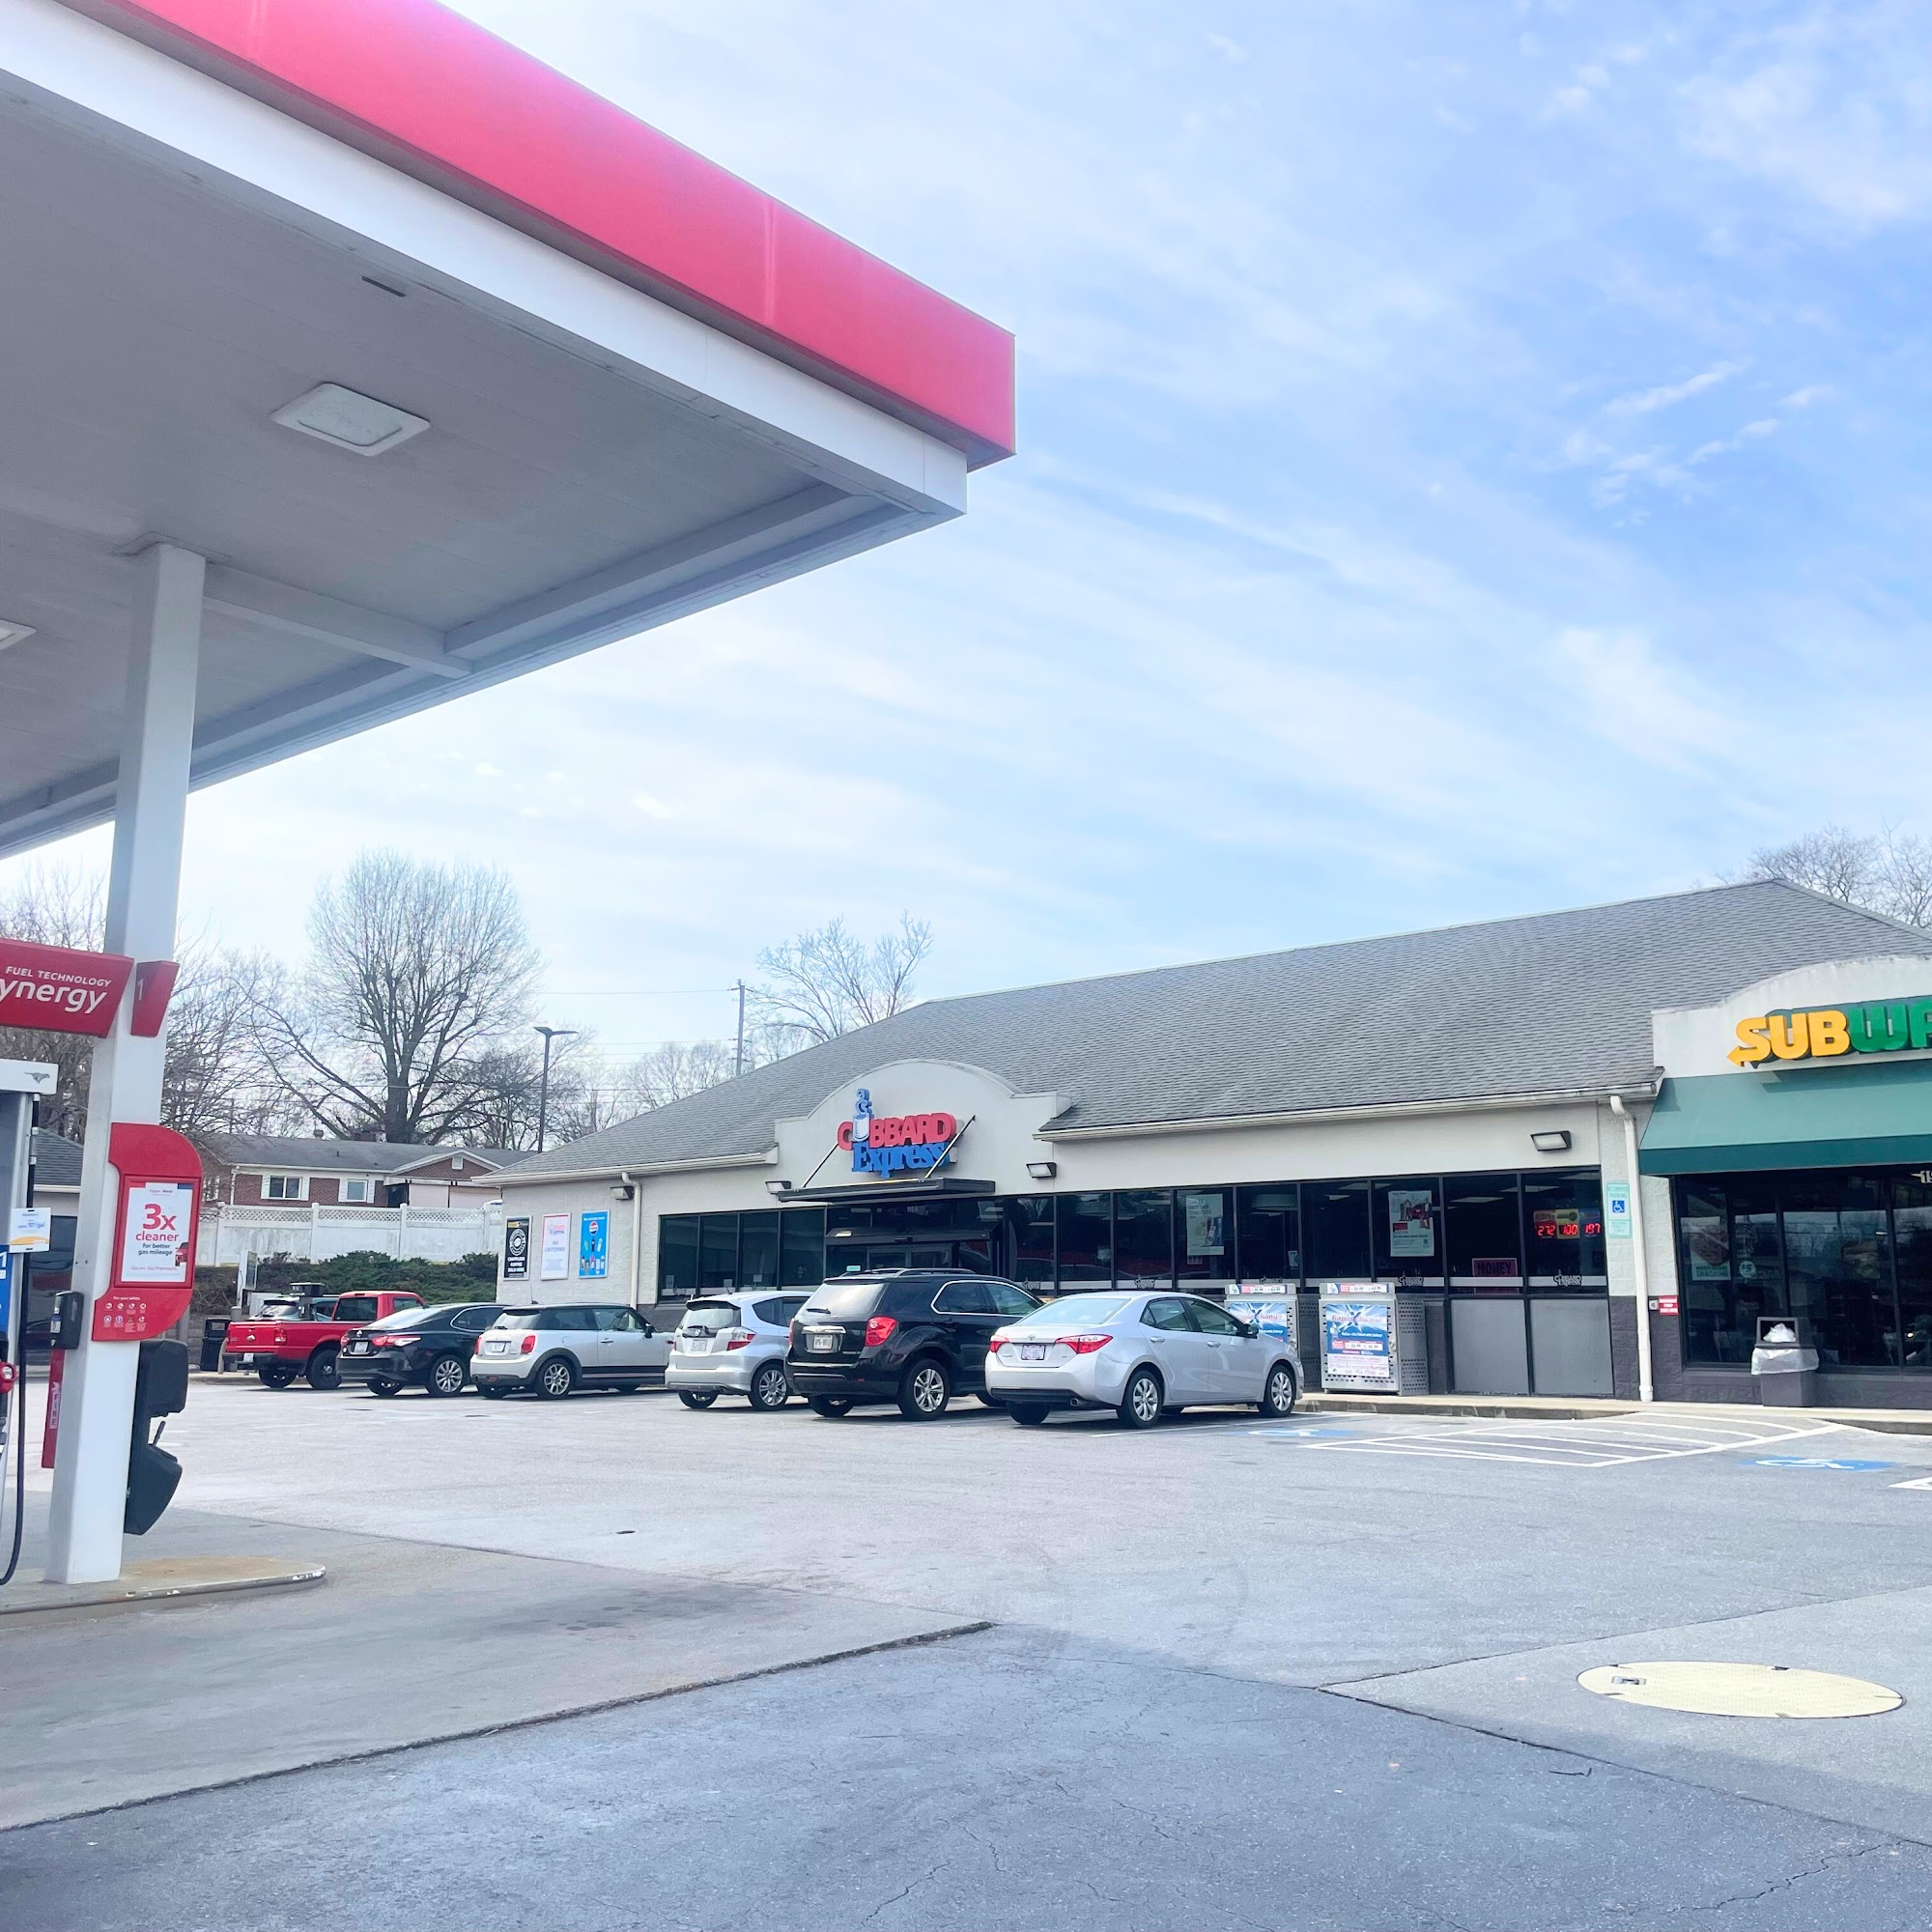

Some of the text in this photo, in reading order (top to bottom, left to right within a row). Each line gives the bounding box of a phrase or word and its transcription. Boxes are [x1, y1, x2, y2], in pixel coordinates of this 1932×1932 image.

[6, 966, 112, 987] FUEL TECHNOLOGY
[838, 1112, 956, 1151] CBBARD
[852, 1142, 948, 1178] Express
[142, 1203, 177, 1231] 3x
[135, 1230, 179, 1242] cleaner
[1584, 1223, 1601, 1234] 197
[1477, 1262, 1513, 1275] MONEY
